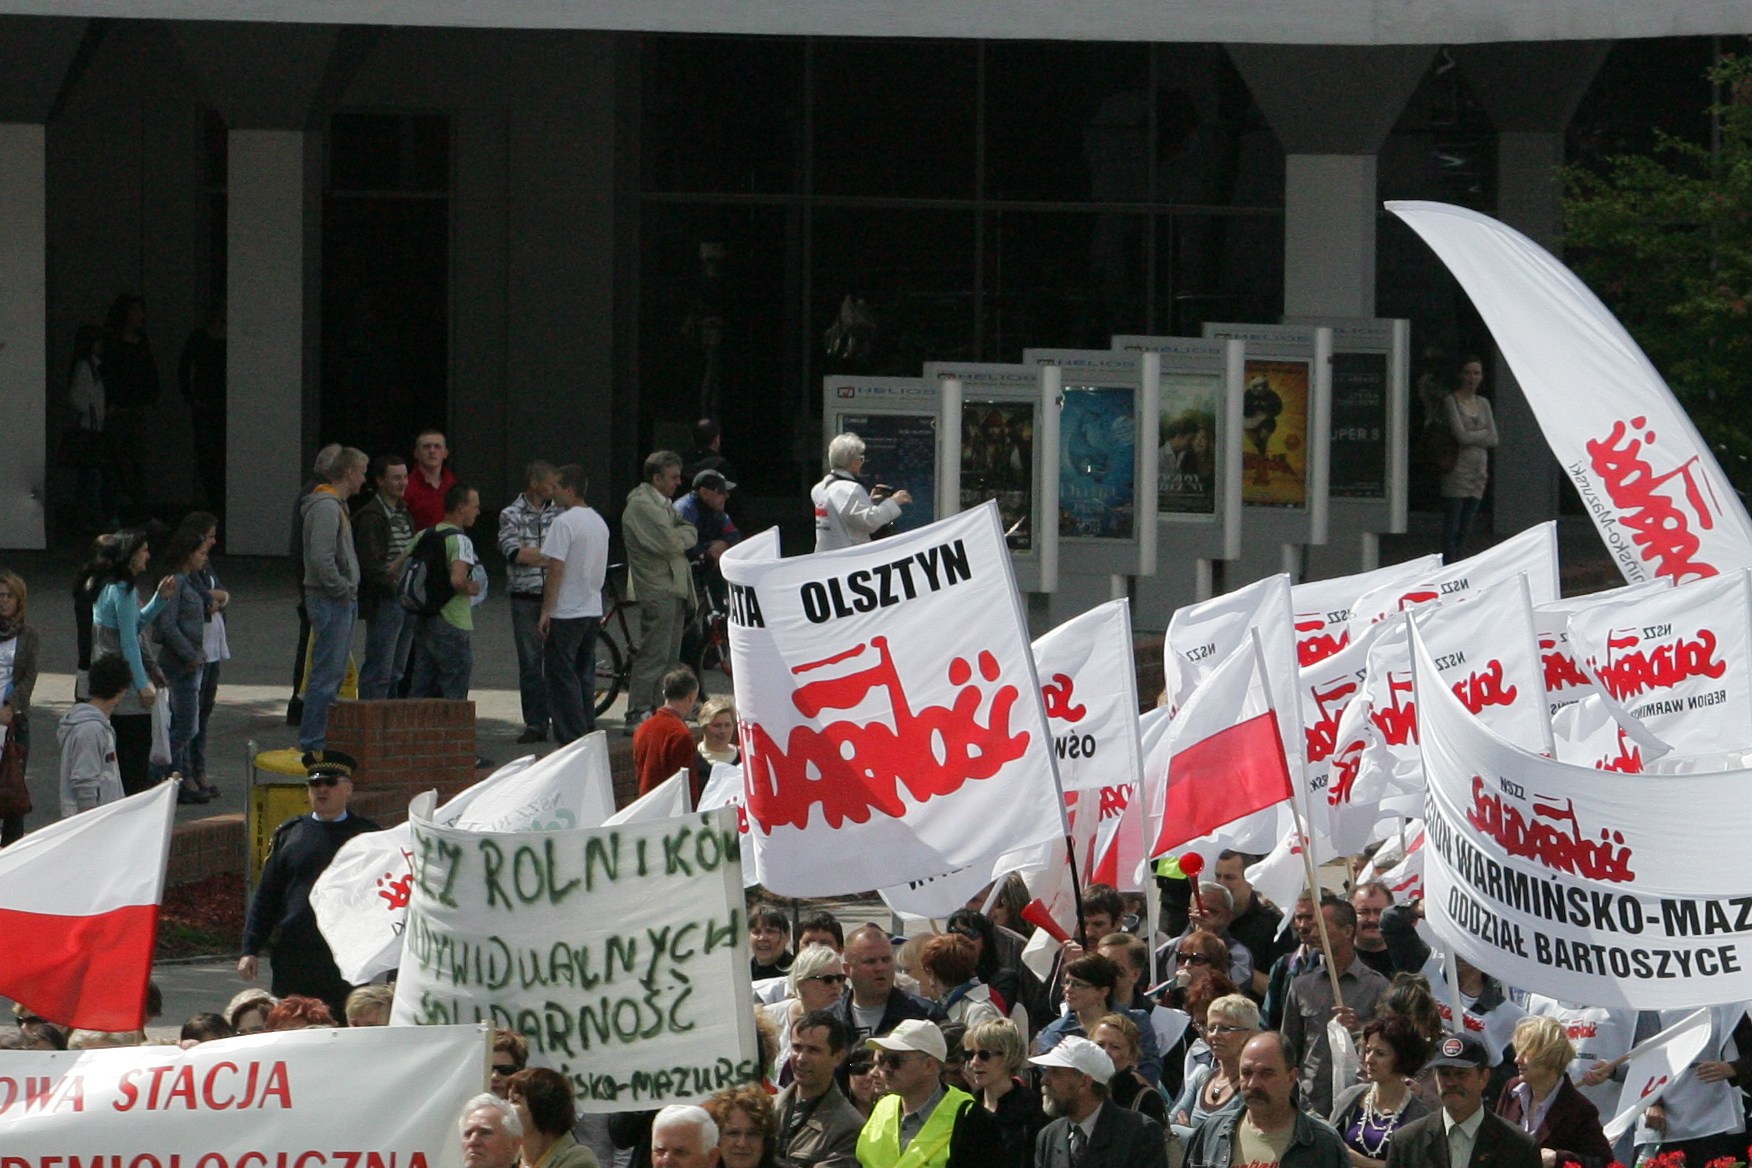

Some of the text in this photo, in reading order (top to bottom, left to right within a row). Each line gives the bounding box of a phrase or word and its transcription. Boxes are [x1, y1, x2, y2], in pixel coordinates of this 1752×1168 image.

[800, 539, 972, 624] OLSZTYN
[1499, 776, 1526, 801] NSZZ
[1447, 884, 1743, 979] ODDZIAŁ BARTOSZYCE
[112, 1060, 293, 1112] STACJA
